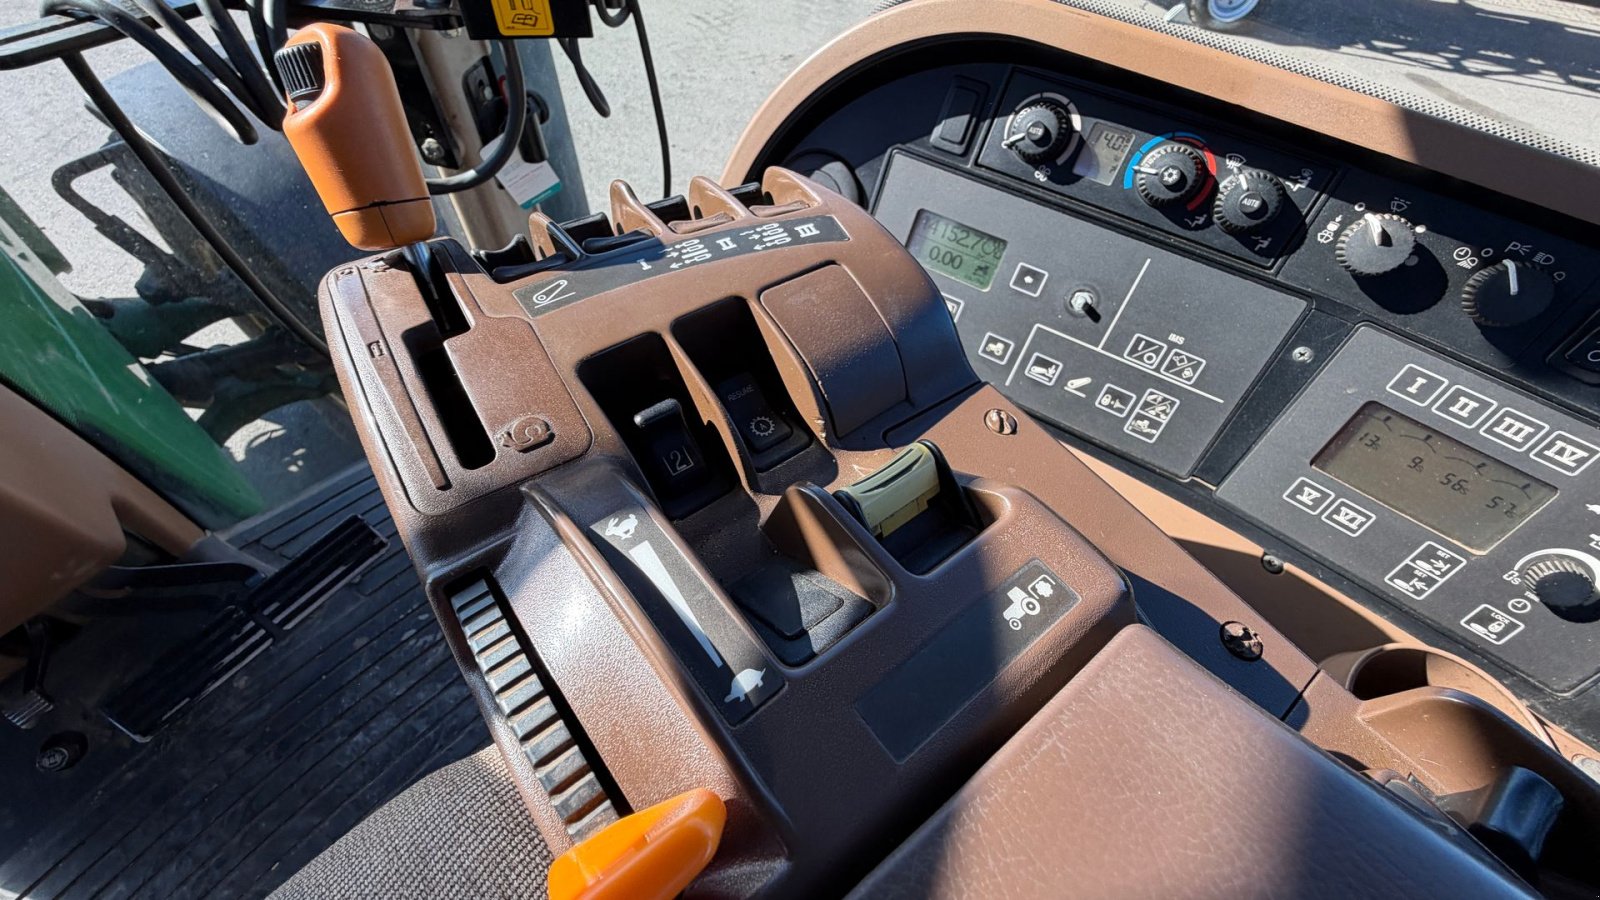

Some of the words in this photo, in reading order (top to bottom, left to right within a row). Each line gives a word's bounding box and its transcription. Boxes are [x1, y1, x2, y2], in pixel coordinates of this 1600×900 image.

[1241, 197, 1260, 208] AUTO
[794, 221, 820, 238] III
[716, 236, 737, 252] II
[928, 245, 963, 270] 0.00
[1168, 332, 1186, 345] IMS
[1405, 376, 1428, 395] I
[1448, 395, 1480, 418] II
[1492, 416, 1536, 444] III
[668, 449, 688, 471] 2
[1542, 439, 1590, 467] IV
[1295, 486, 1323, 506] V
[1332, 506, 1368, 531] VI
[1436, 550, 1451, 560] SET
[1413, 569, 1429, 579] SET
[1490, 612, 1511, 625] LOCK
